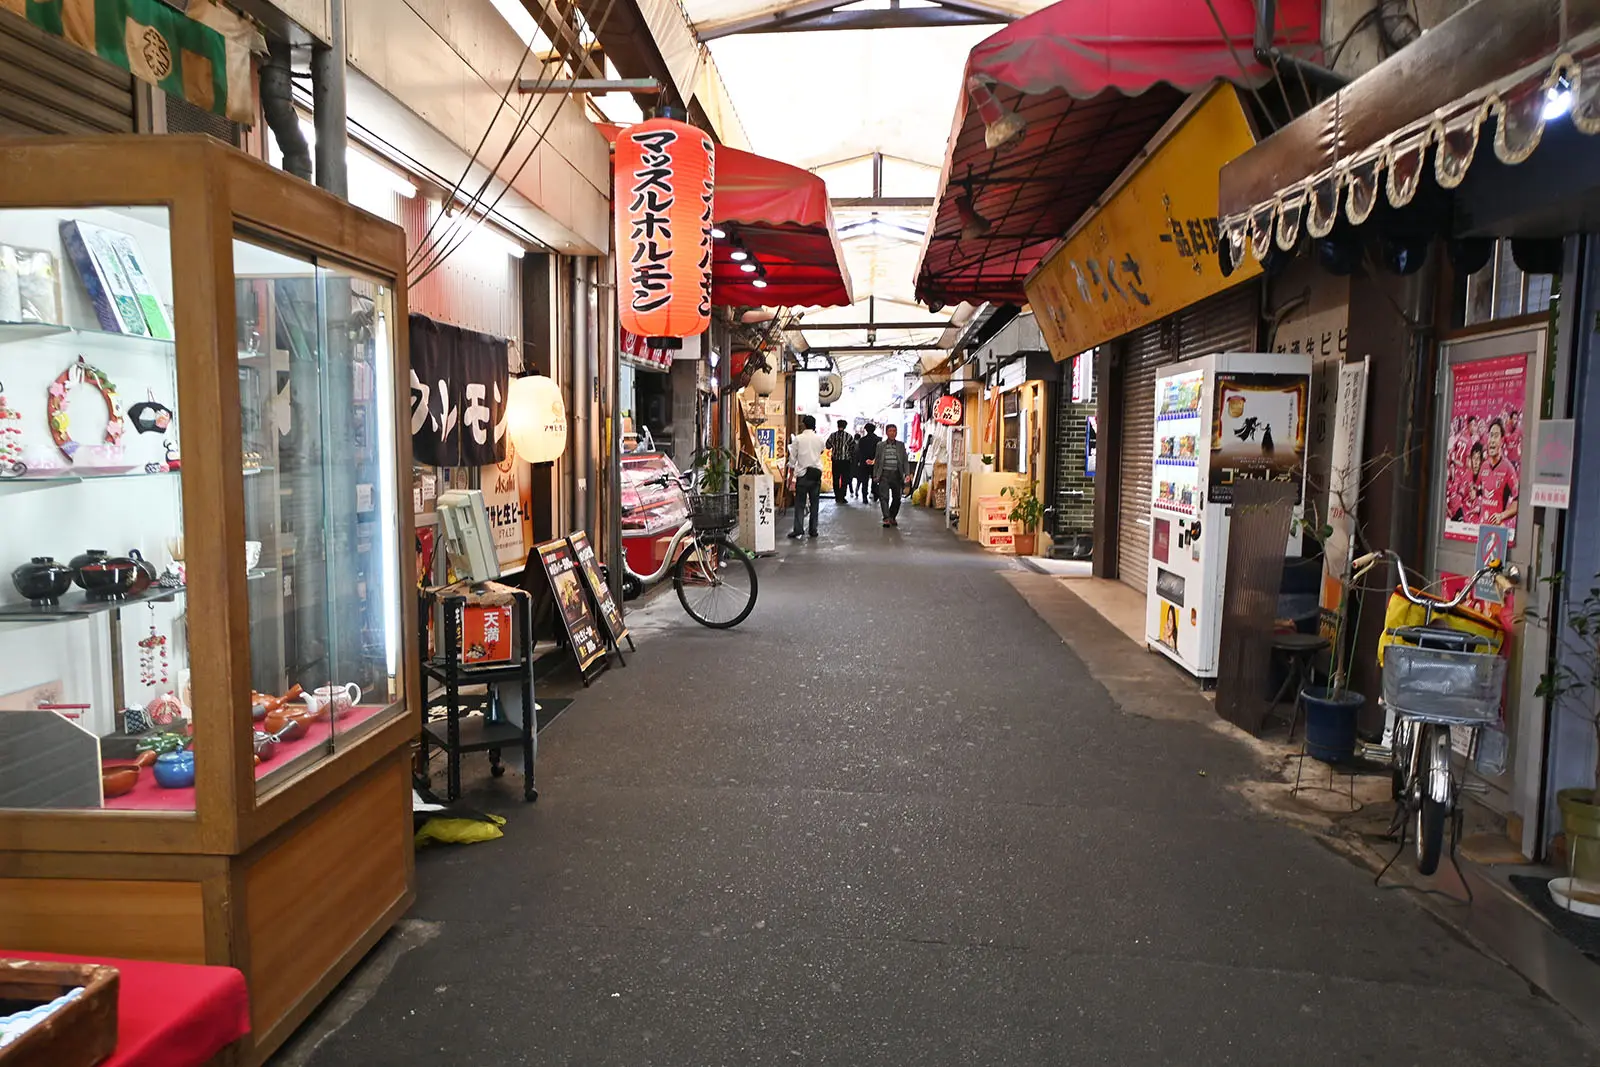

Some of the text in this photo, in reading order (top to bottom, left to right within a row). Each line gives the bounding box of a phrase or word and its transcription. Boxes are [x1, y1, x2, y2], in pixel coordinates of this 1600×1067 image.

[629, 130, 677, 314] マッスルホルモン
[495, 473, 516, 495] Asahi
[484, 611, 500, 643] 天満
